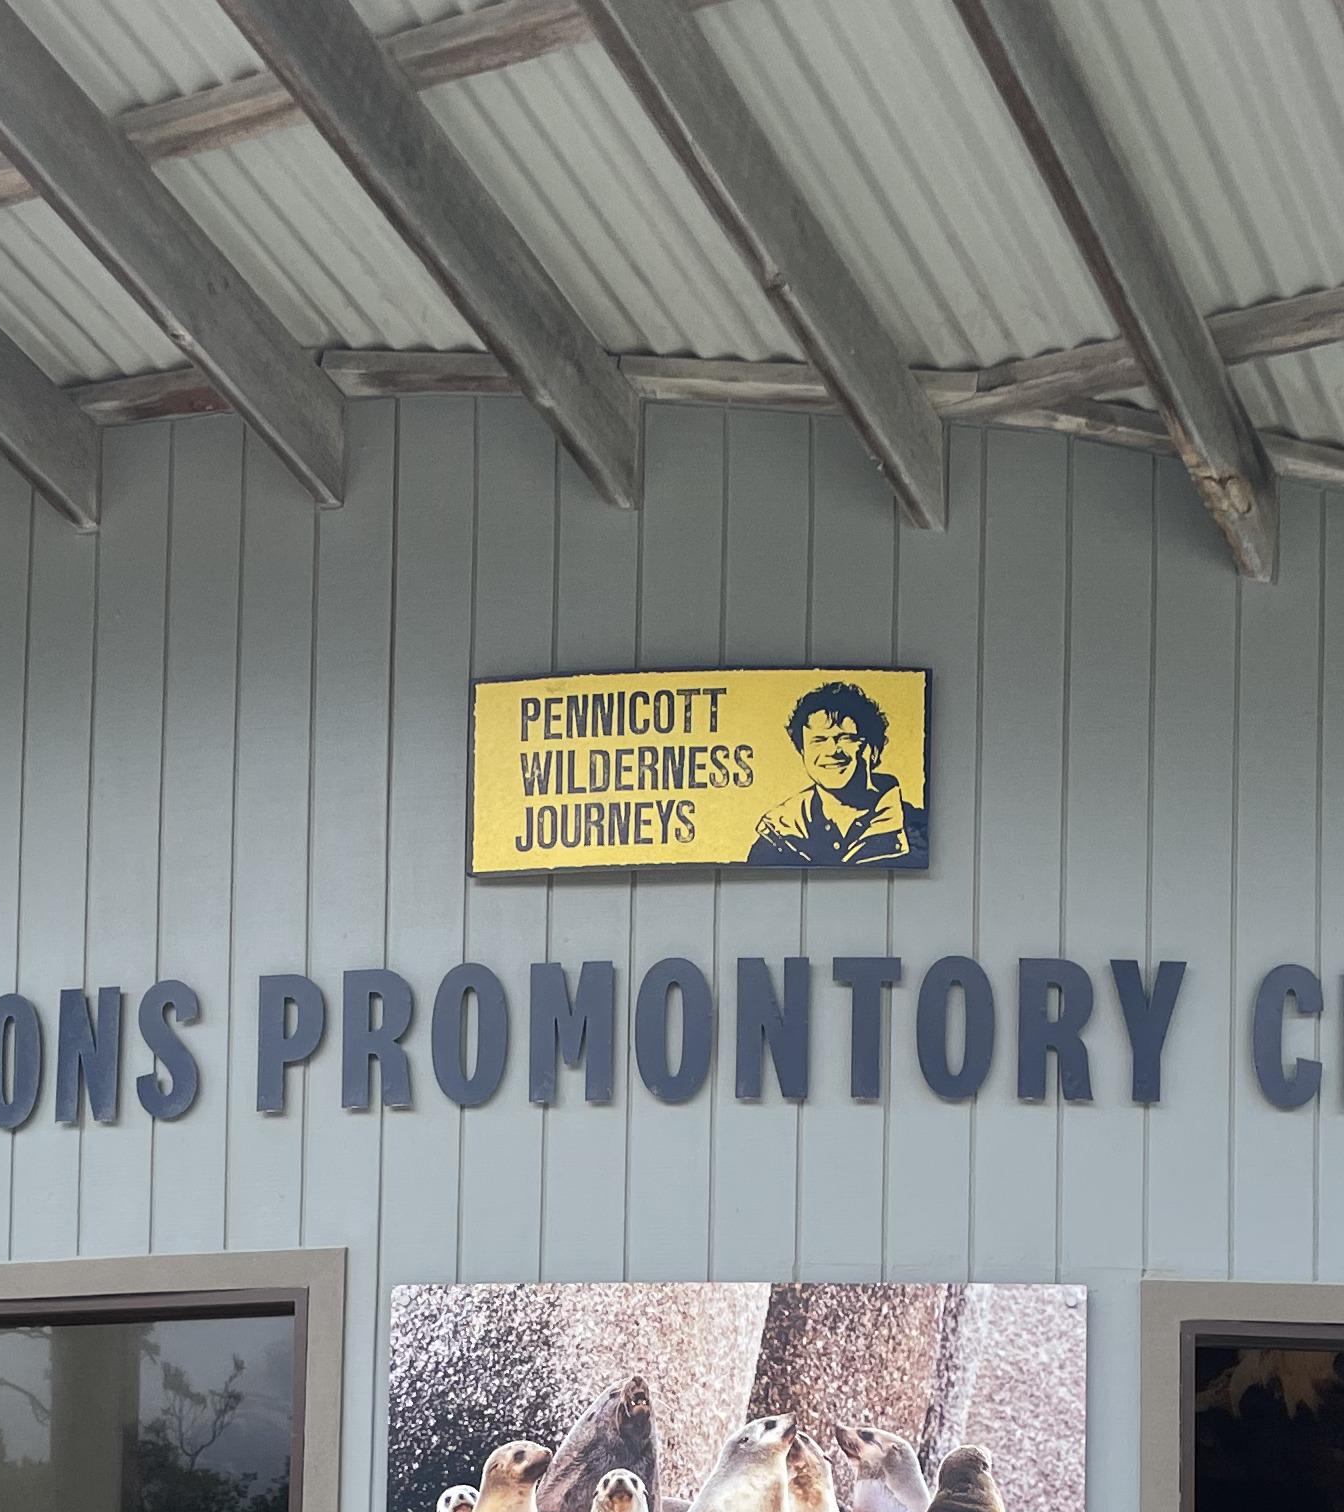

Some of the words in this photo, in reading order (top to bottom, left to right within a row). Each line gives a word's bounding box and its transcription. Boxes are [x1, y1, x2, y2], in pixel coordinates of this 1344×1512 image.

[521, 687, 728, 742] PENNICOTT
[519, 744, 754, 797] WILDERNESS
[514, 799, 696, 852] JOURNEYS
[256, 955, 1187, 1113] PROMONTORY
